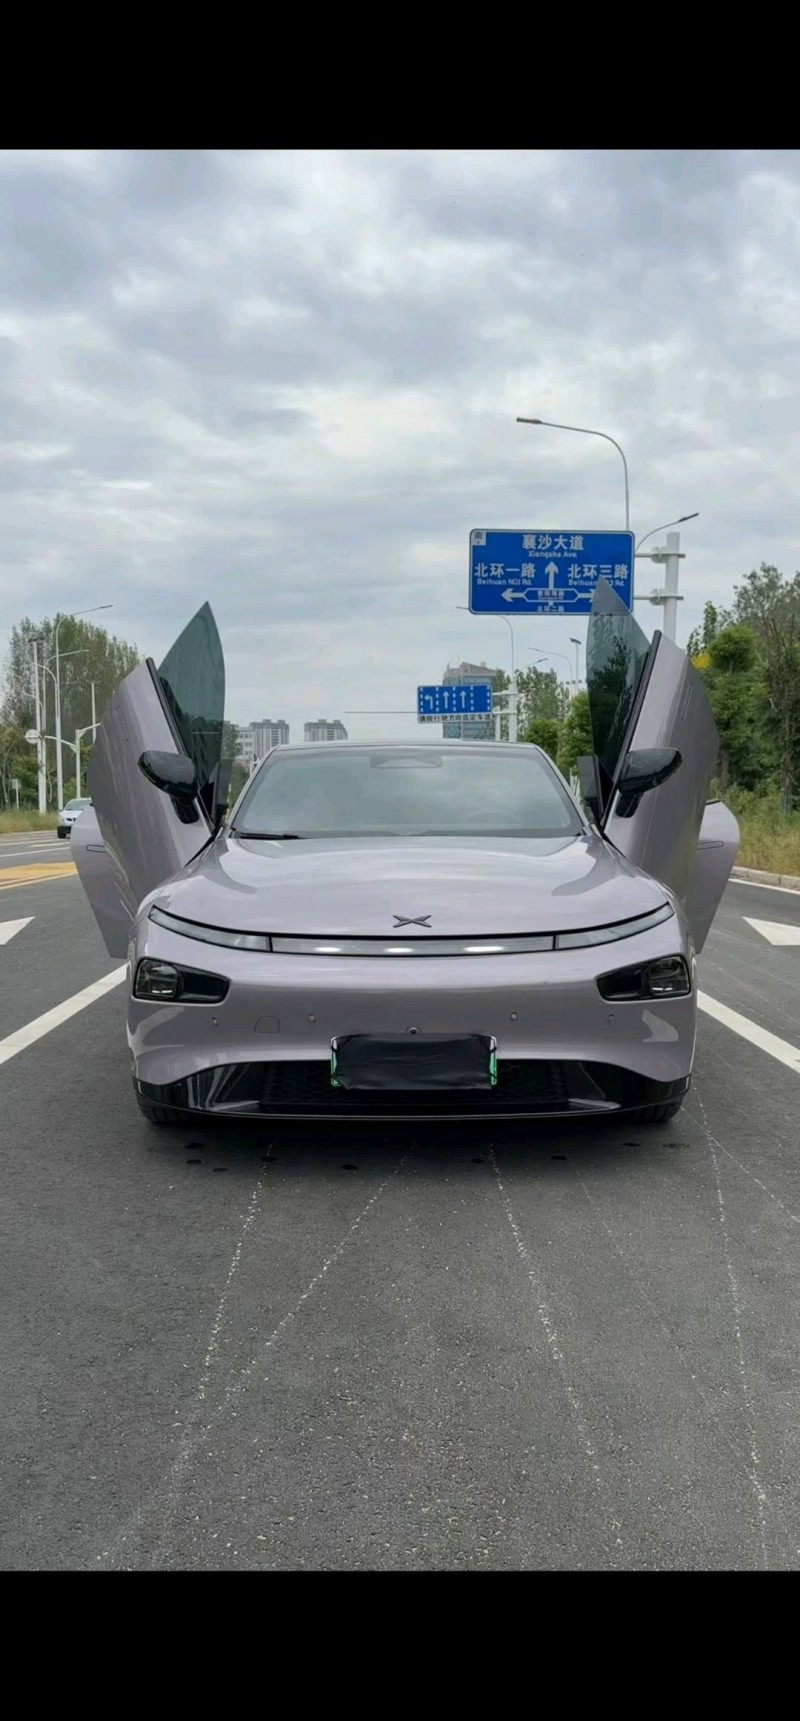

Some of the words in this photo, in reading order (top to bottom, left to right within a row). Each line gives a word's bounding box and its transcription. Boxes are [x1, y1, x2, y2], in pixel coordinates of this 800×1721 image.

[522, 533, 585, 551] 襄沙大道
[528, 550, 561, 559] Xiangsha
[474, 562, 536, 579] 北环一路
[567, 563, 629, 580] 北环三路
